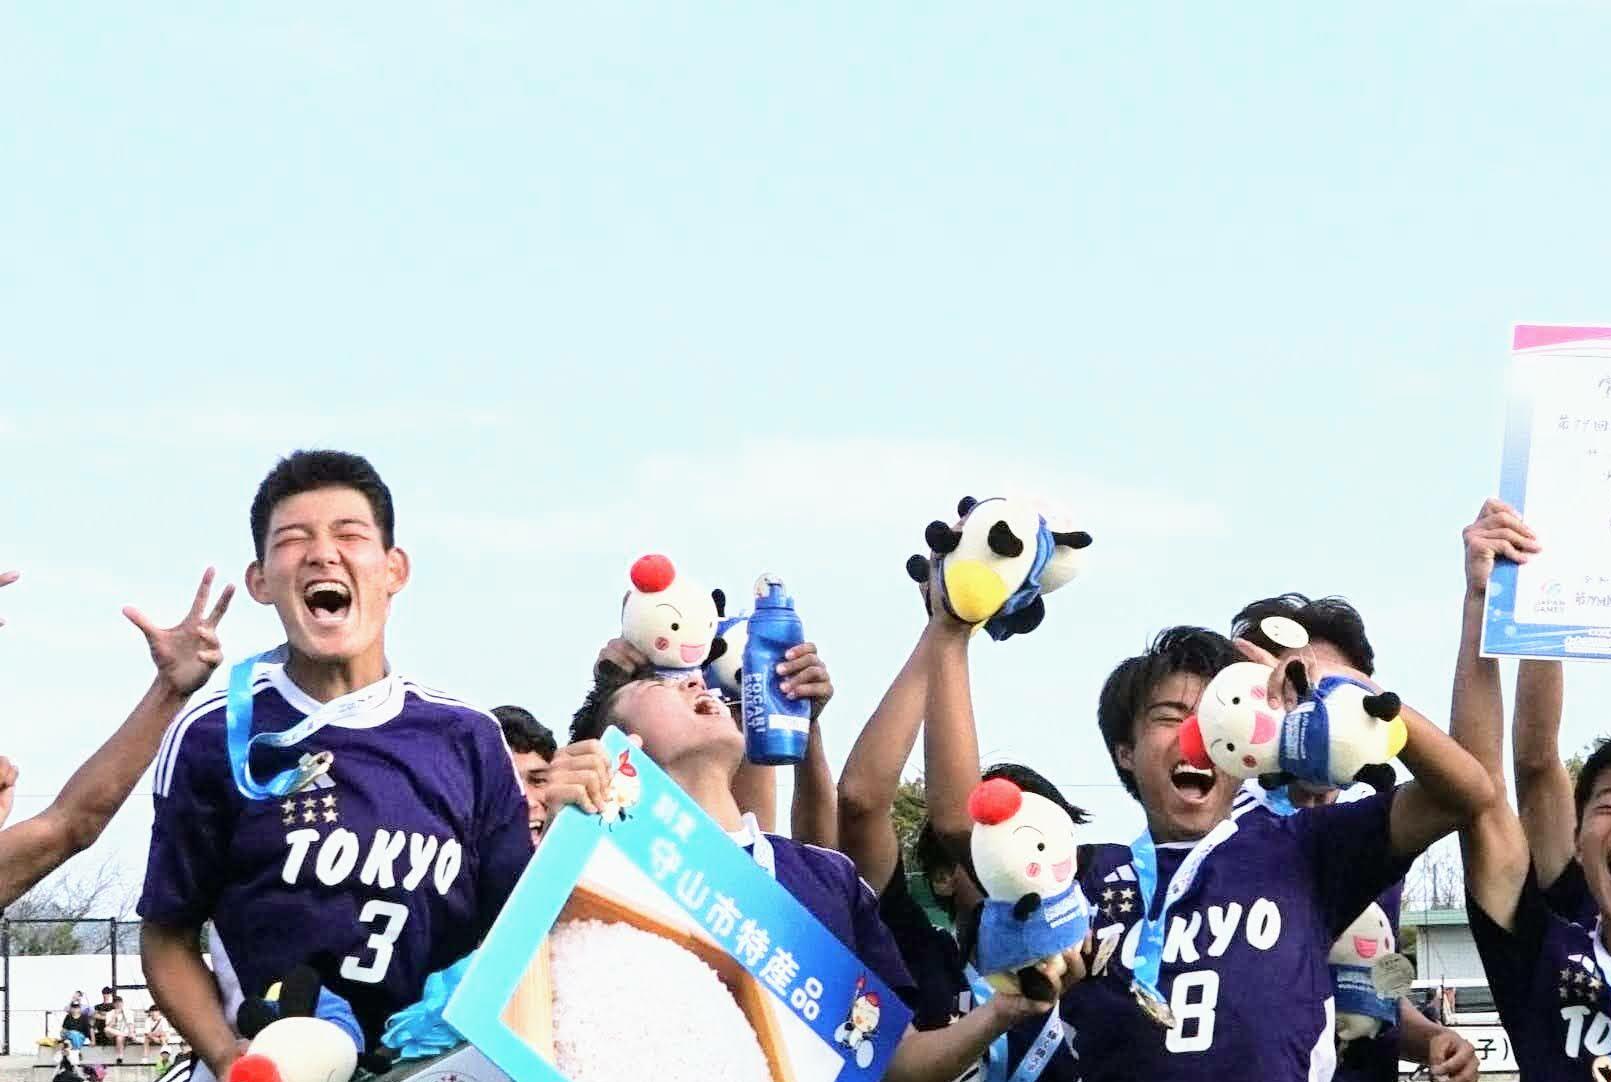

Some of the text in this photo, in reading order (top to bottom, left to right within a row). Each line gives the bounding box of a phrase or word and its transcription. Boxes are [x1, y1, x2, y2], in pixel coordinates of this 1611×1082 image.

[752, 671, 768, 734] POCARI
[282, 828, 462, 895] TOKYO
[340, 900, 409, 983] 3
[650, 838, 823, 1020] 守山市特産品
[1165, 969, 1219, 1052] 8
